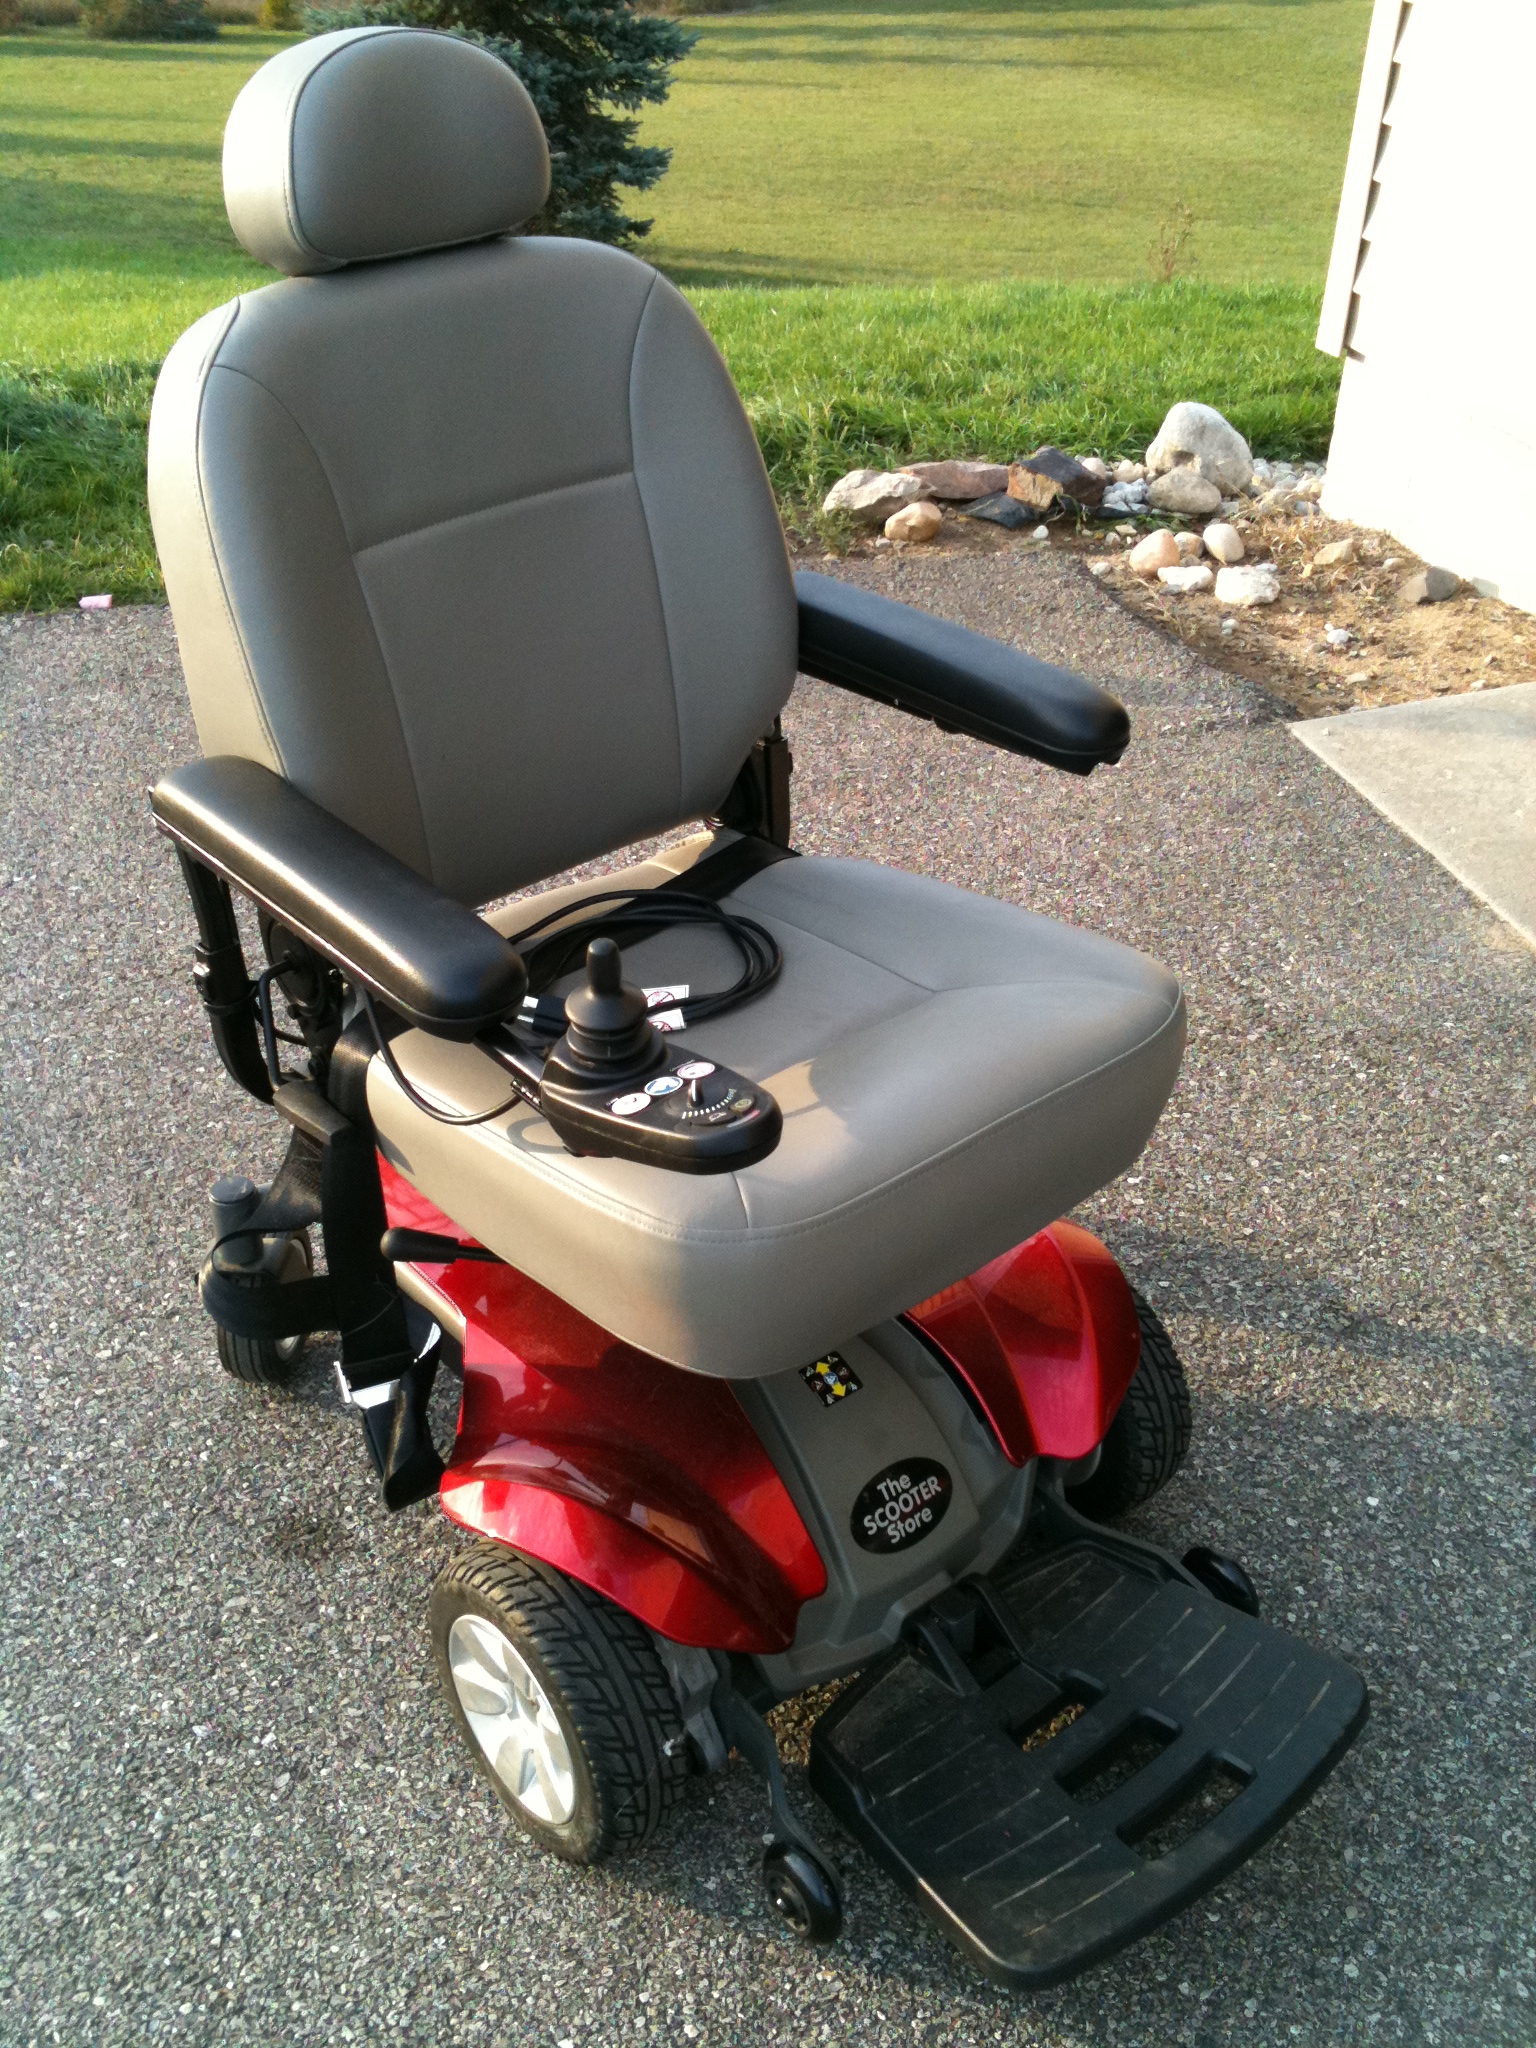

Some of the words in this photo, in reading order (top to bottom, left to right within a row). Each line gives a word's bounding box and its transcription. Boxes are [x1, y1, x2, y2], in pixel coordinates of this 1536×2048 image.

[863, 1476, 942, 1535] SCOOTER
[877, 1475, 911, 1501] The
[887, 1507, 933, 1543] Store
